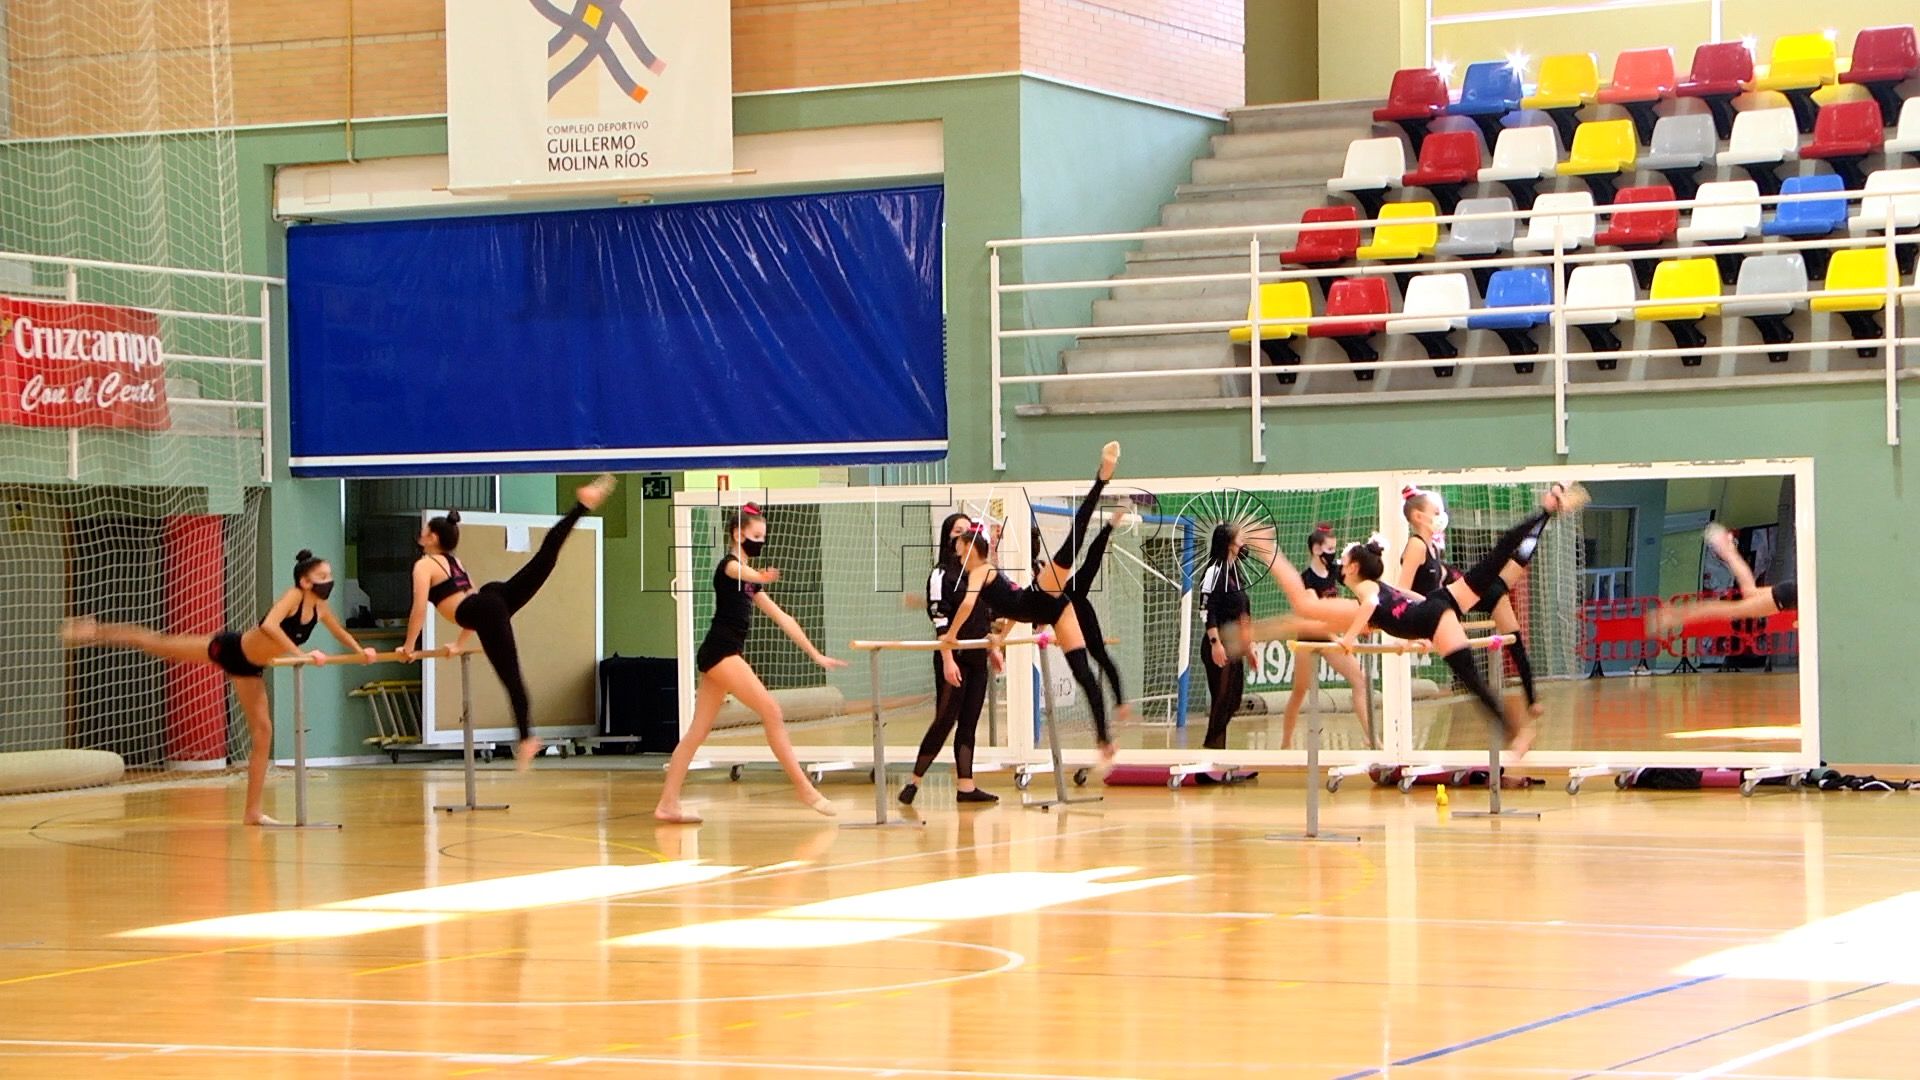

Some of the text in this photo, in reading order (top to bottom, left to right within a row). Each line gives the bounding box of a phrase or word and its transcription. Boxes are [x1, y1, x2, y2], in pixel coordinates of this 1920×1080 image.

[546, 120, 649, 135] COMPLEJO DEPORTIVO
[547, 134, 636, 154] GUILLERMO
[548, 150, 649, 172] MOLINA RÍOS
[14, 317, 163, 372] Cruzcampo
[21, 374, 66, 411] Con
[74, 376, 93, 404] el
